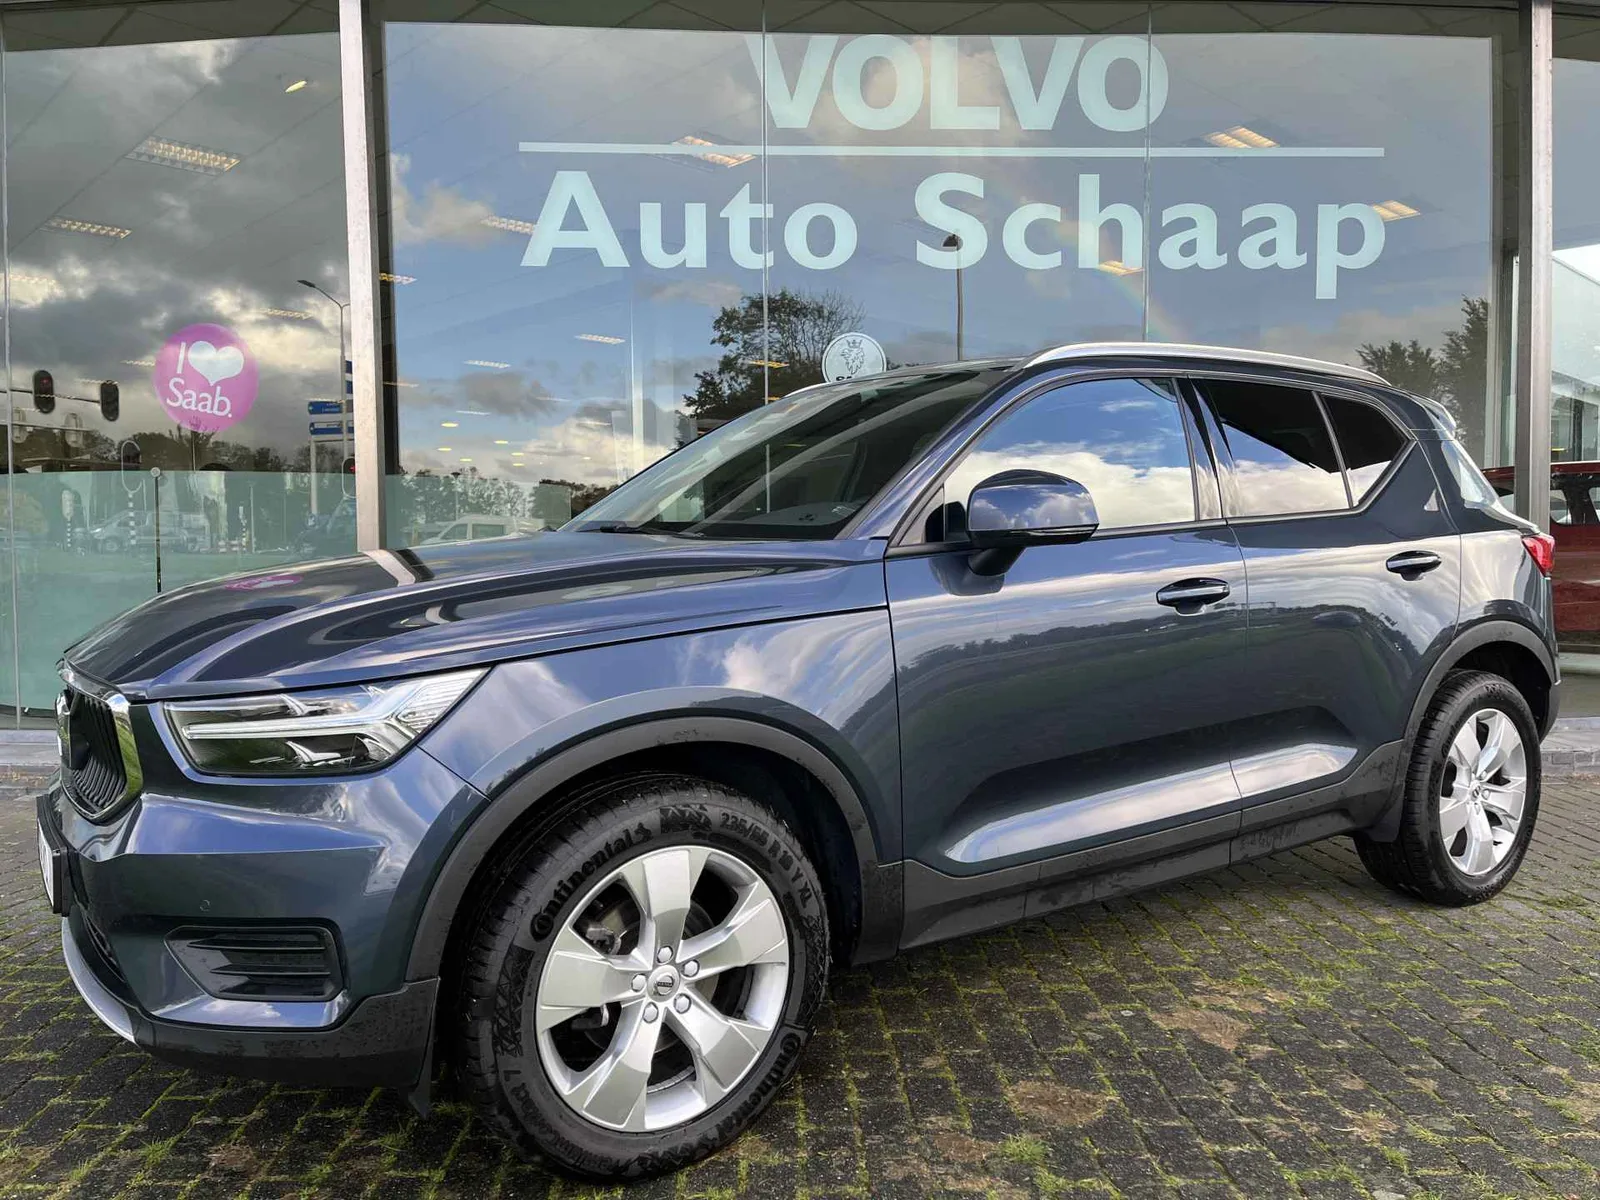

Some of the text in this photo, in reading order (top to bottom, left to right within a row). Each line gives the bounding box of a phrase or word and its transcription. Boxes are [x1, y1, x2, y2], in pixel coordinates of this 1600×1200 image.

[744, 33, 1169, 132] VOLVO
[520, 170, 1386, 299] Auto Schaap
[166, 377, 232, 418] Saab.
[176, 341, 187, 374] I
[530, 828, 634, 943] Continental
